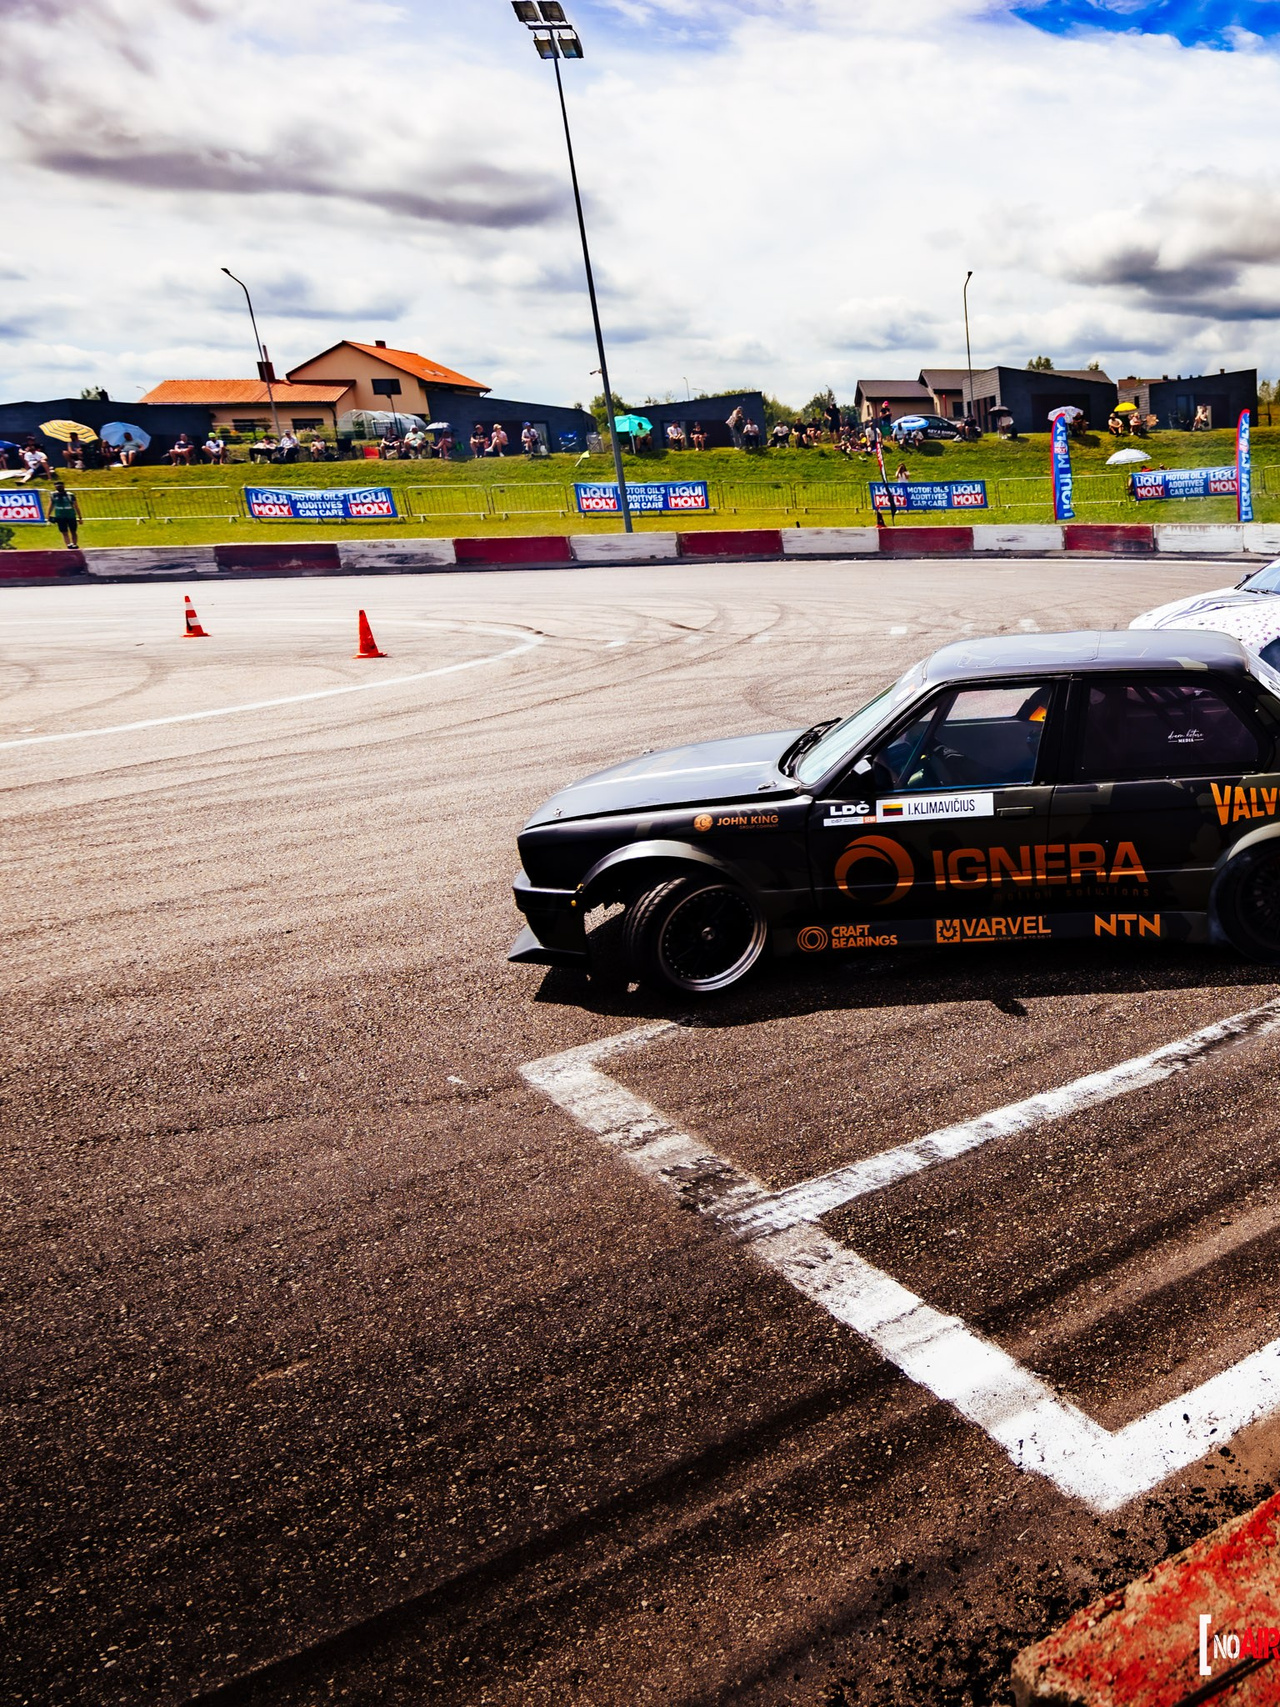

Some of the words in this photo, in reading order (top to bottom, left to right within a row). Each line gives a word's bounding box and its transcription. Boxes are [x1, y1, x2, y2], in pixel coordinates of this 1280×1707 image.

[1166, 473, 1189, 481] MOTOR
[1210, 469, 1237, 480] LIQU
[1136, 476, 1162, 486] LIQUI
[1169, 480, 1204, 488] ADDITIVES
[581, 487, 614, 498] LIQUI
[670, 486, 702, 497] LIQUI
[953, 484, 981, 494] LIQUI
[1137, 486, 1163, 497] MOLY
[252, 492, 288, 504] LIQUI
[324, 493, 344, 501] OILS
[349, 491, 387, 503] LIQUI
[954, 494, 983, 504] MOLY
[1059, 473, 1073, 517] LIQUI
[1241, 473, 1252, 520] LIQUI
[297, 501, 343, 509] ADDITIVES
[582, 499, 616, 509] MOLY
[670, 497, 705, 507] MOLY
[254, 504, 292, 515] MOLY
[350, 503, 391, 515] MOLY
[830, 801, 870, 816] LDČ
[908, 798, 975, 815] I.KLIMAVIČIUS
[717, 816, 748, 826] JOHN
[751, 815, 779, 824] KING
[932, 841, 1149, 891] IGNERA
[831, 924, 870, 937] CRAFT
[962, 916, 1051, 937] VARVEL
[1094, 914, 1161, 937] NTN
[832, 935, 898, 949] BEARINGS
